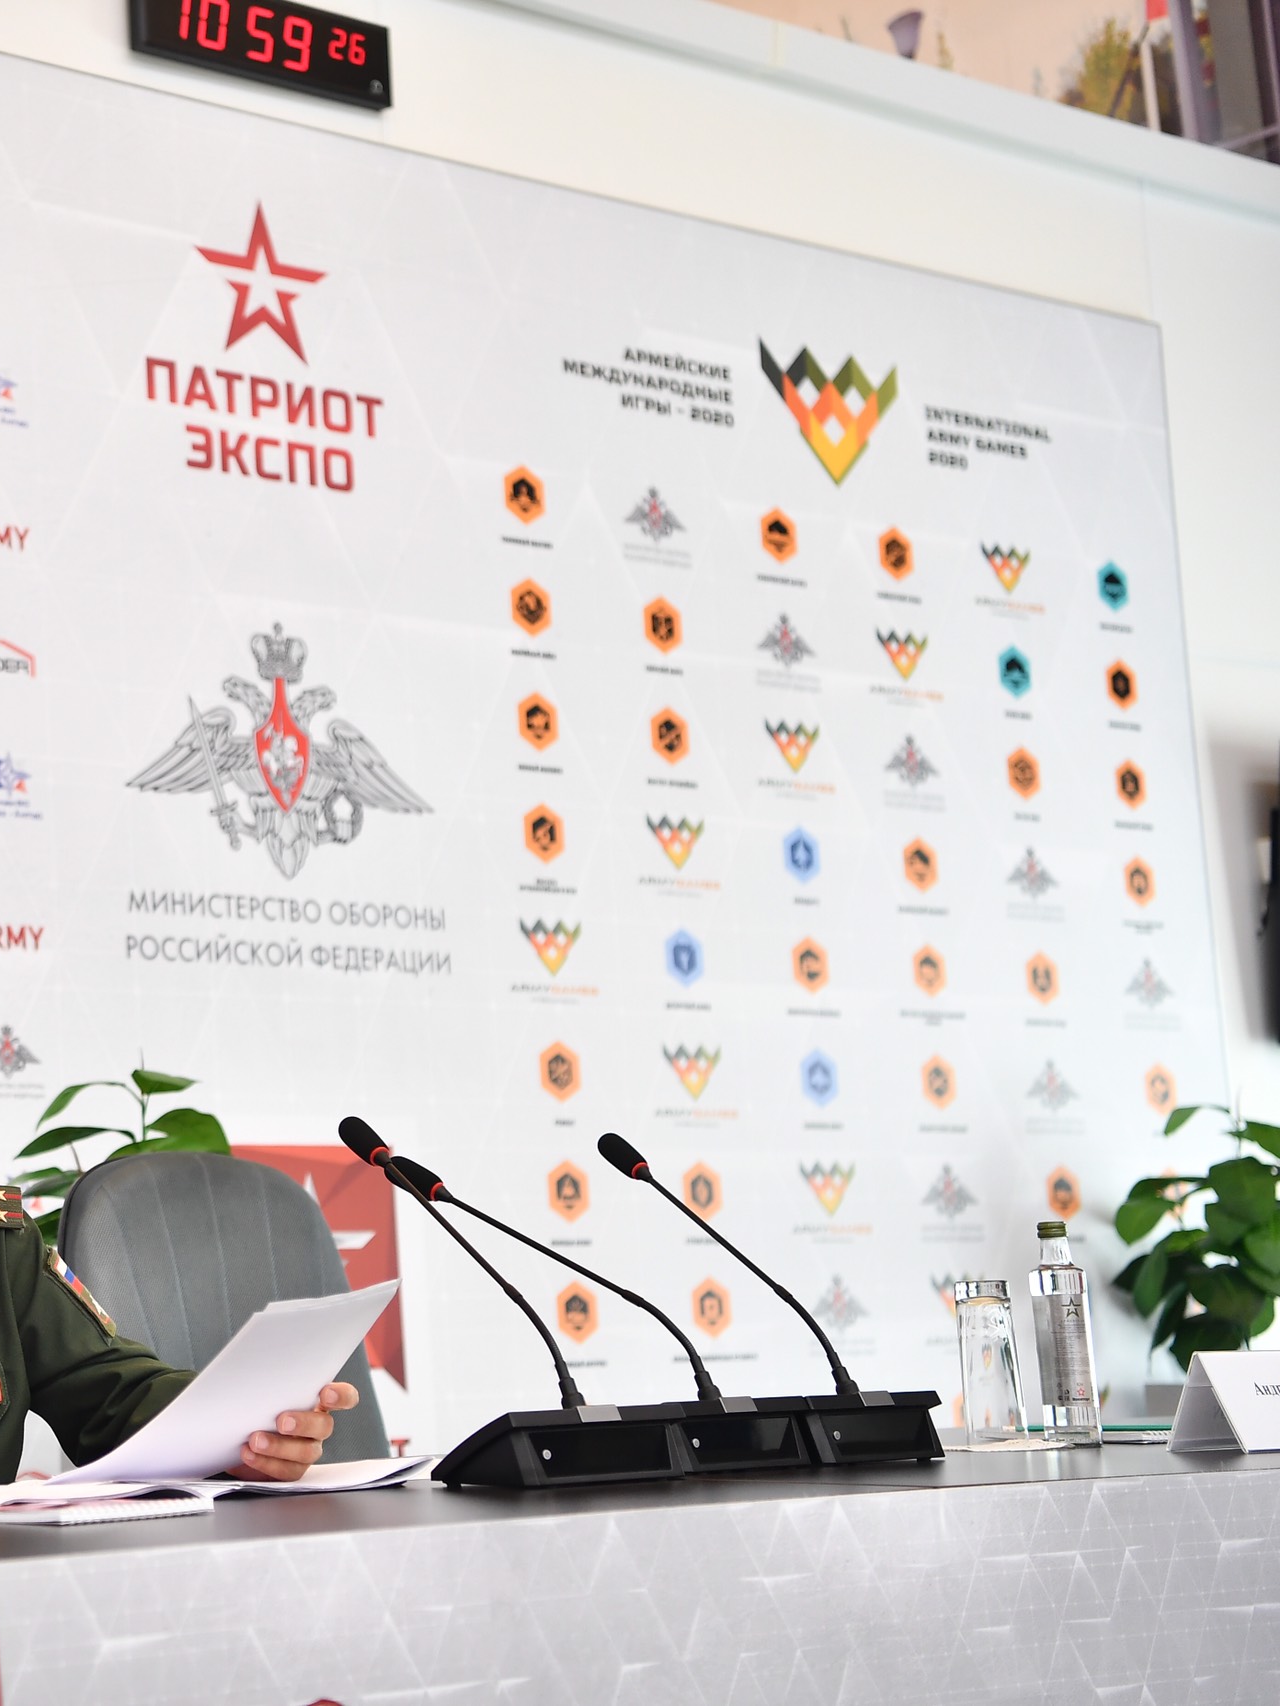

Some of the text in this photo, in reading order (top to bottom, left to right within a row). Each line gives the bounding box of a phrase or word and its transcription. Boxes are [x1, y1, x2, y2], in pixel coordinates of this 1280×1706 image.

[246, 6, 313, 72] 59
[328, 27, 366, 66] 26
[563, 359, 733, 403] МЕЖДУНАРОДНЫЕ
[624, 347, 731, 381] АРМЕЙСКИЕ
[145, 356, 383, 438] ПАТРИОТ
[621, 394, 671, 416] ИГРЫ
[925, 405, 1051, 442] INTERNATIONAL
[185, 423, 355, 493] ЭКСПО
[928, 430, 1027, 460] ARMY GAMES
[128, 890, 446, 931] МИНИСТЕРСТВО ОБОРОНЫ
[126, 934, 451, 976] РОССИЙСКОЙ ФЕДЕРАЦИИ
